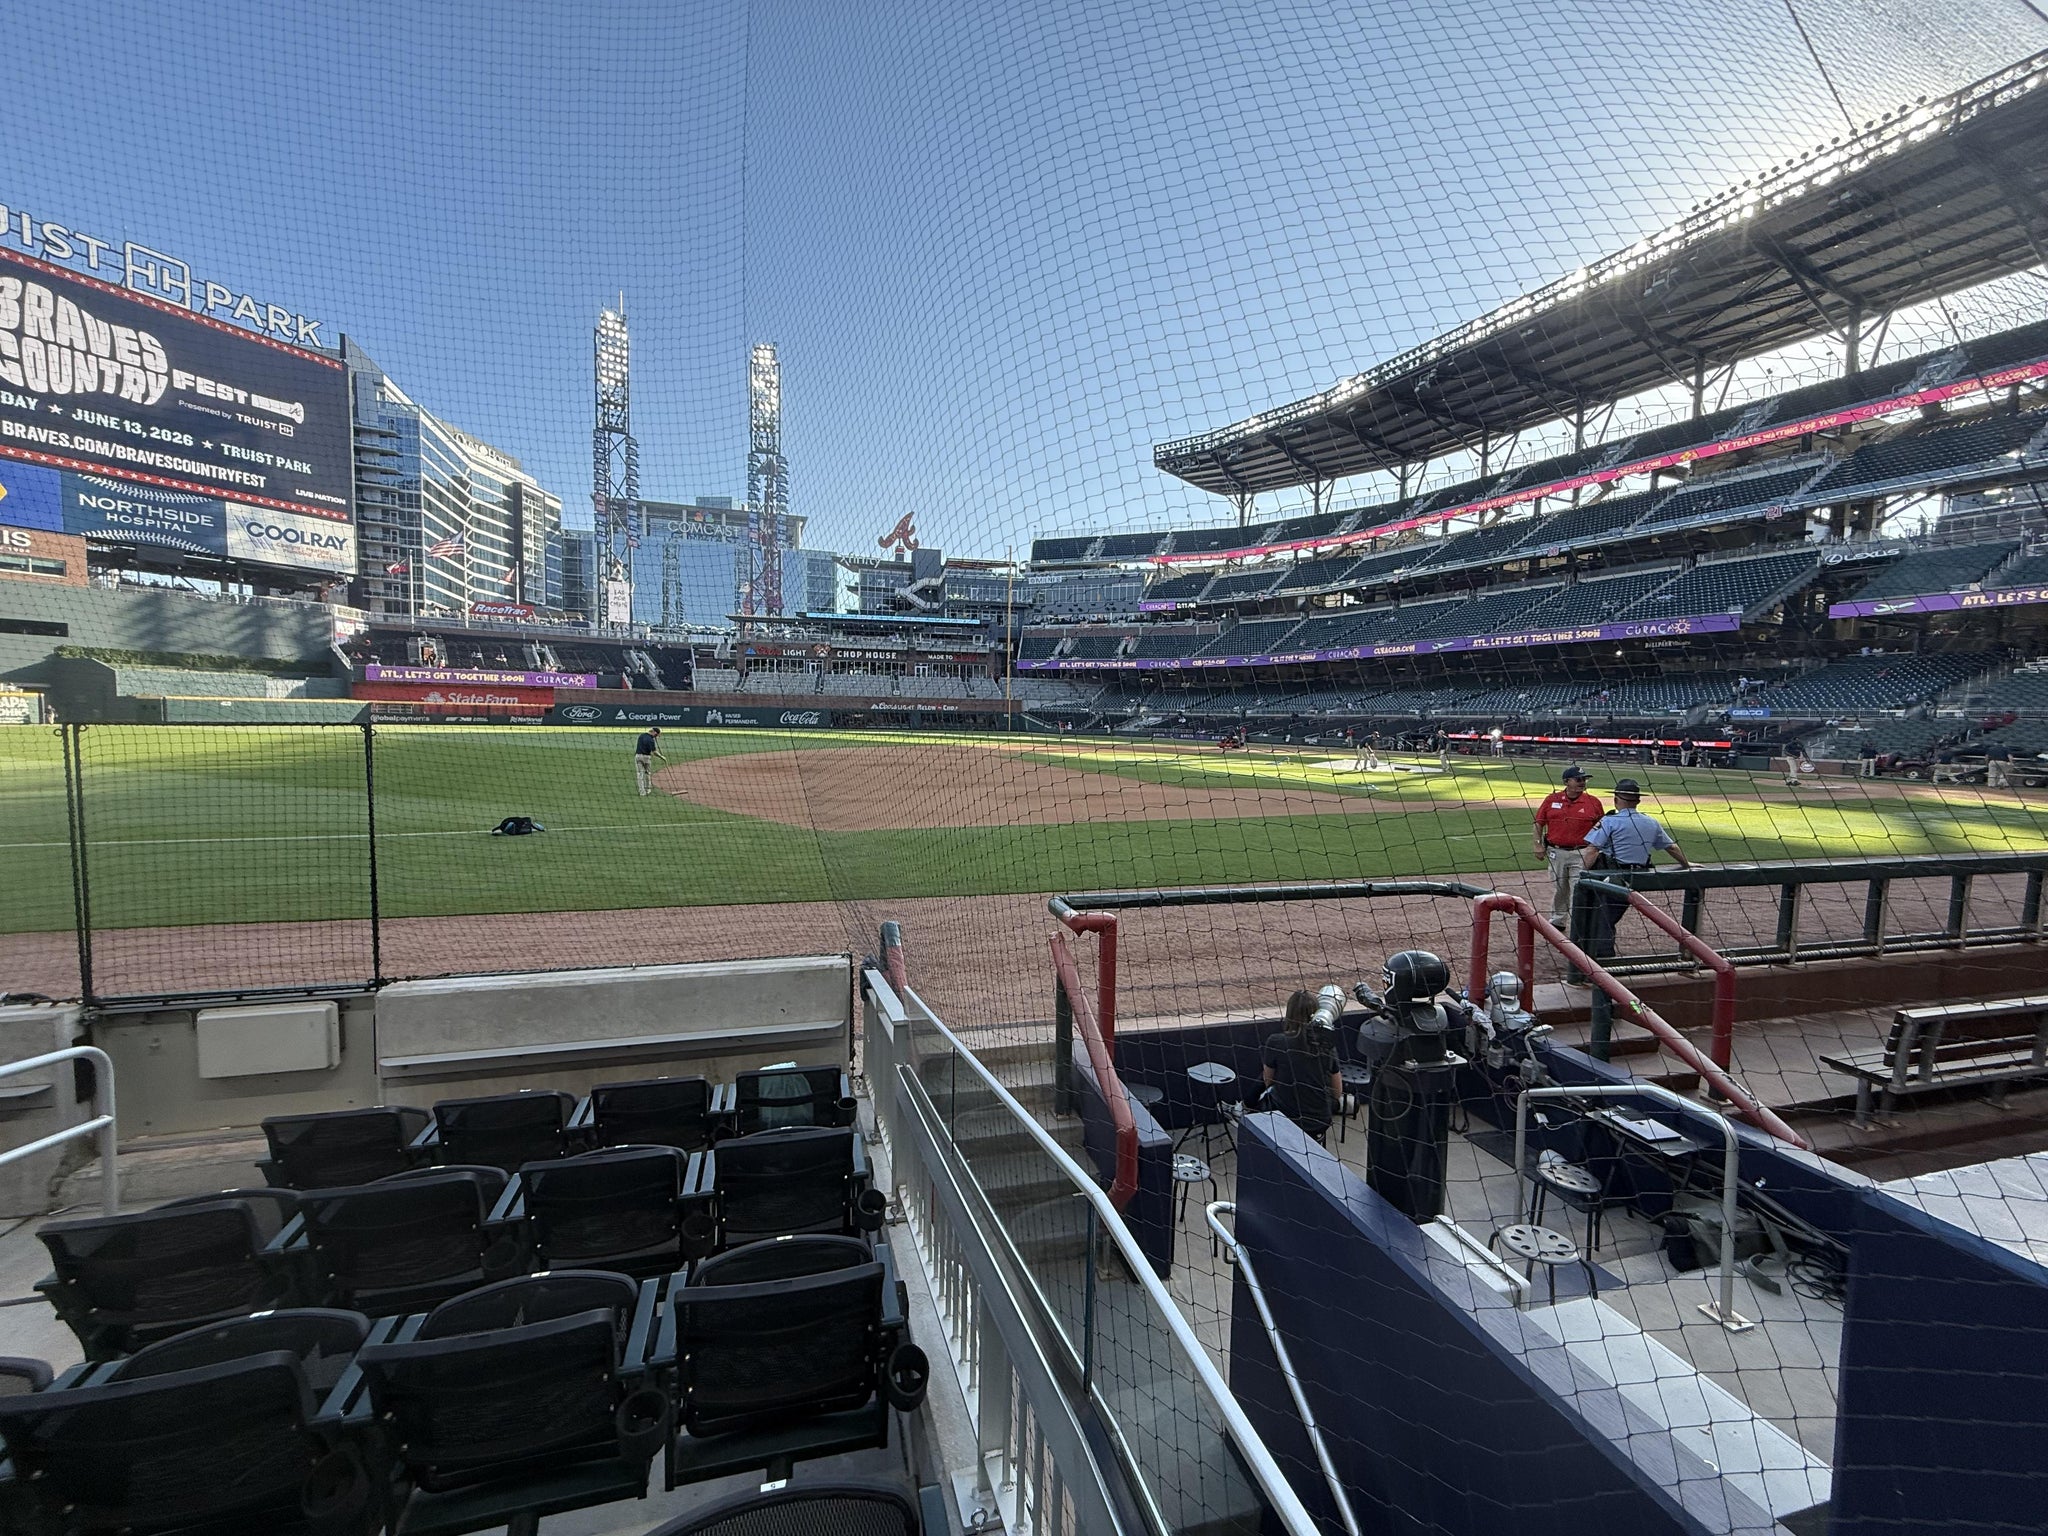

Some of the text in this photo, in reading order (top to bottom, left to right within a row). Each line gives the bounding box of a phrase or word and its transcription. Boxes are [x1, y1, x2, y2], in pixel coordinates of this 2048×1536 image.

[204, 279, 323, 348] PARK
[0, 277, 168, 374] BRAVES
[0, 328, 249, 406] COUNTRY FEST
[178, 399, 278, 431] Presented by TRUIST
[1762, 426, 1799, 441] WAITING
[1800, 421, 1817, 432] FOR
[1819, 416, 1837, 427] YOU
[71, 408, 121, 431] JUNE
[123, 419, 147, 439] 13,
[150, 426, 194, 447] 2026
[220, 442, 275, 466] TRUIST
[276, 456, 312, 475] PARK
[2, 420, 267, 488] BRAVES.COM/BRAVESCOUNTRYFEST
[295, 488, 346, 505] LIVE NATION
[79, 493, 215, 528] NORTHSIDE
[106, 512, 193, 534] HOSPITAL
[668, 520, 739, 538] COMCAST
[246, 521, 348, 551] COOLRAY
[840, 552, 880, 569] xfinity
[1844, 548, 1900, 561] LEXUS
[1997, 590, 2037, 603] LET'S
[474, 603, 527, 616] RaceTrac
[1473, 629, 1601, 648] ATL, LET'S GET TOGETHER SOON
[782, 649, 807, 657] LIGHT
[836, 650, 897, 660] CHOP HOUSE
[380, 669, 525, 683] ATL, LET'S GET TOGETHER SOON
[569, 706, 595, 719] Ford
[628, 712, 682, 722] Georgia Power
